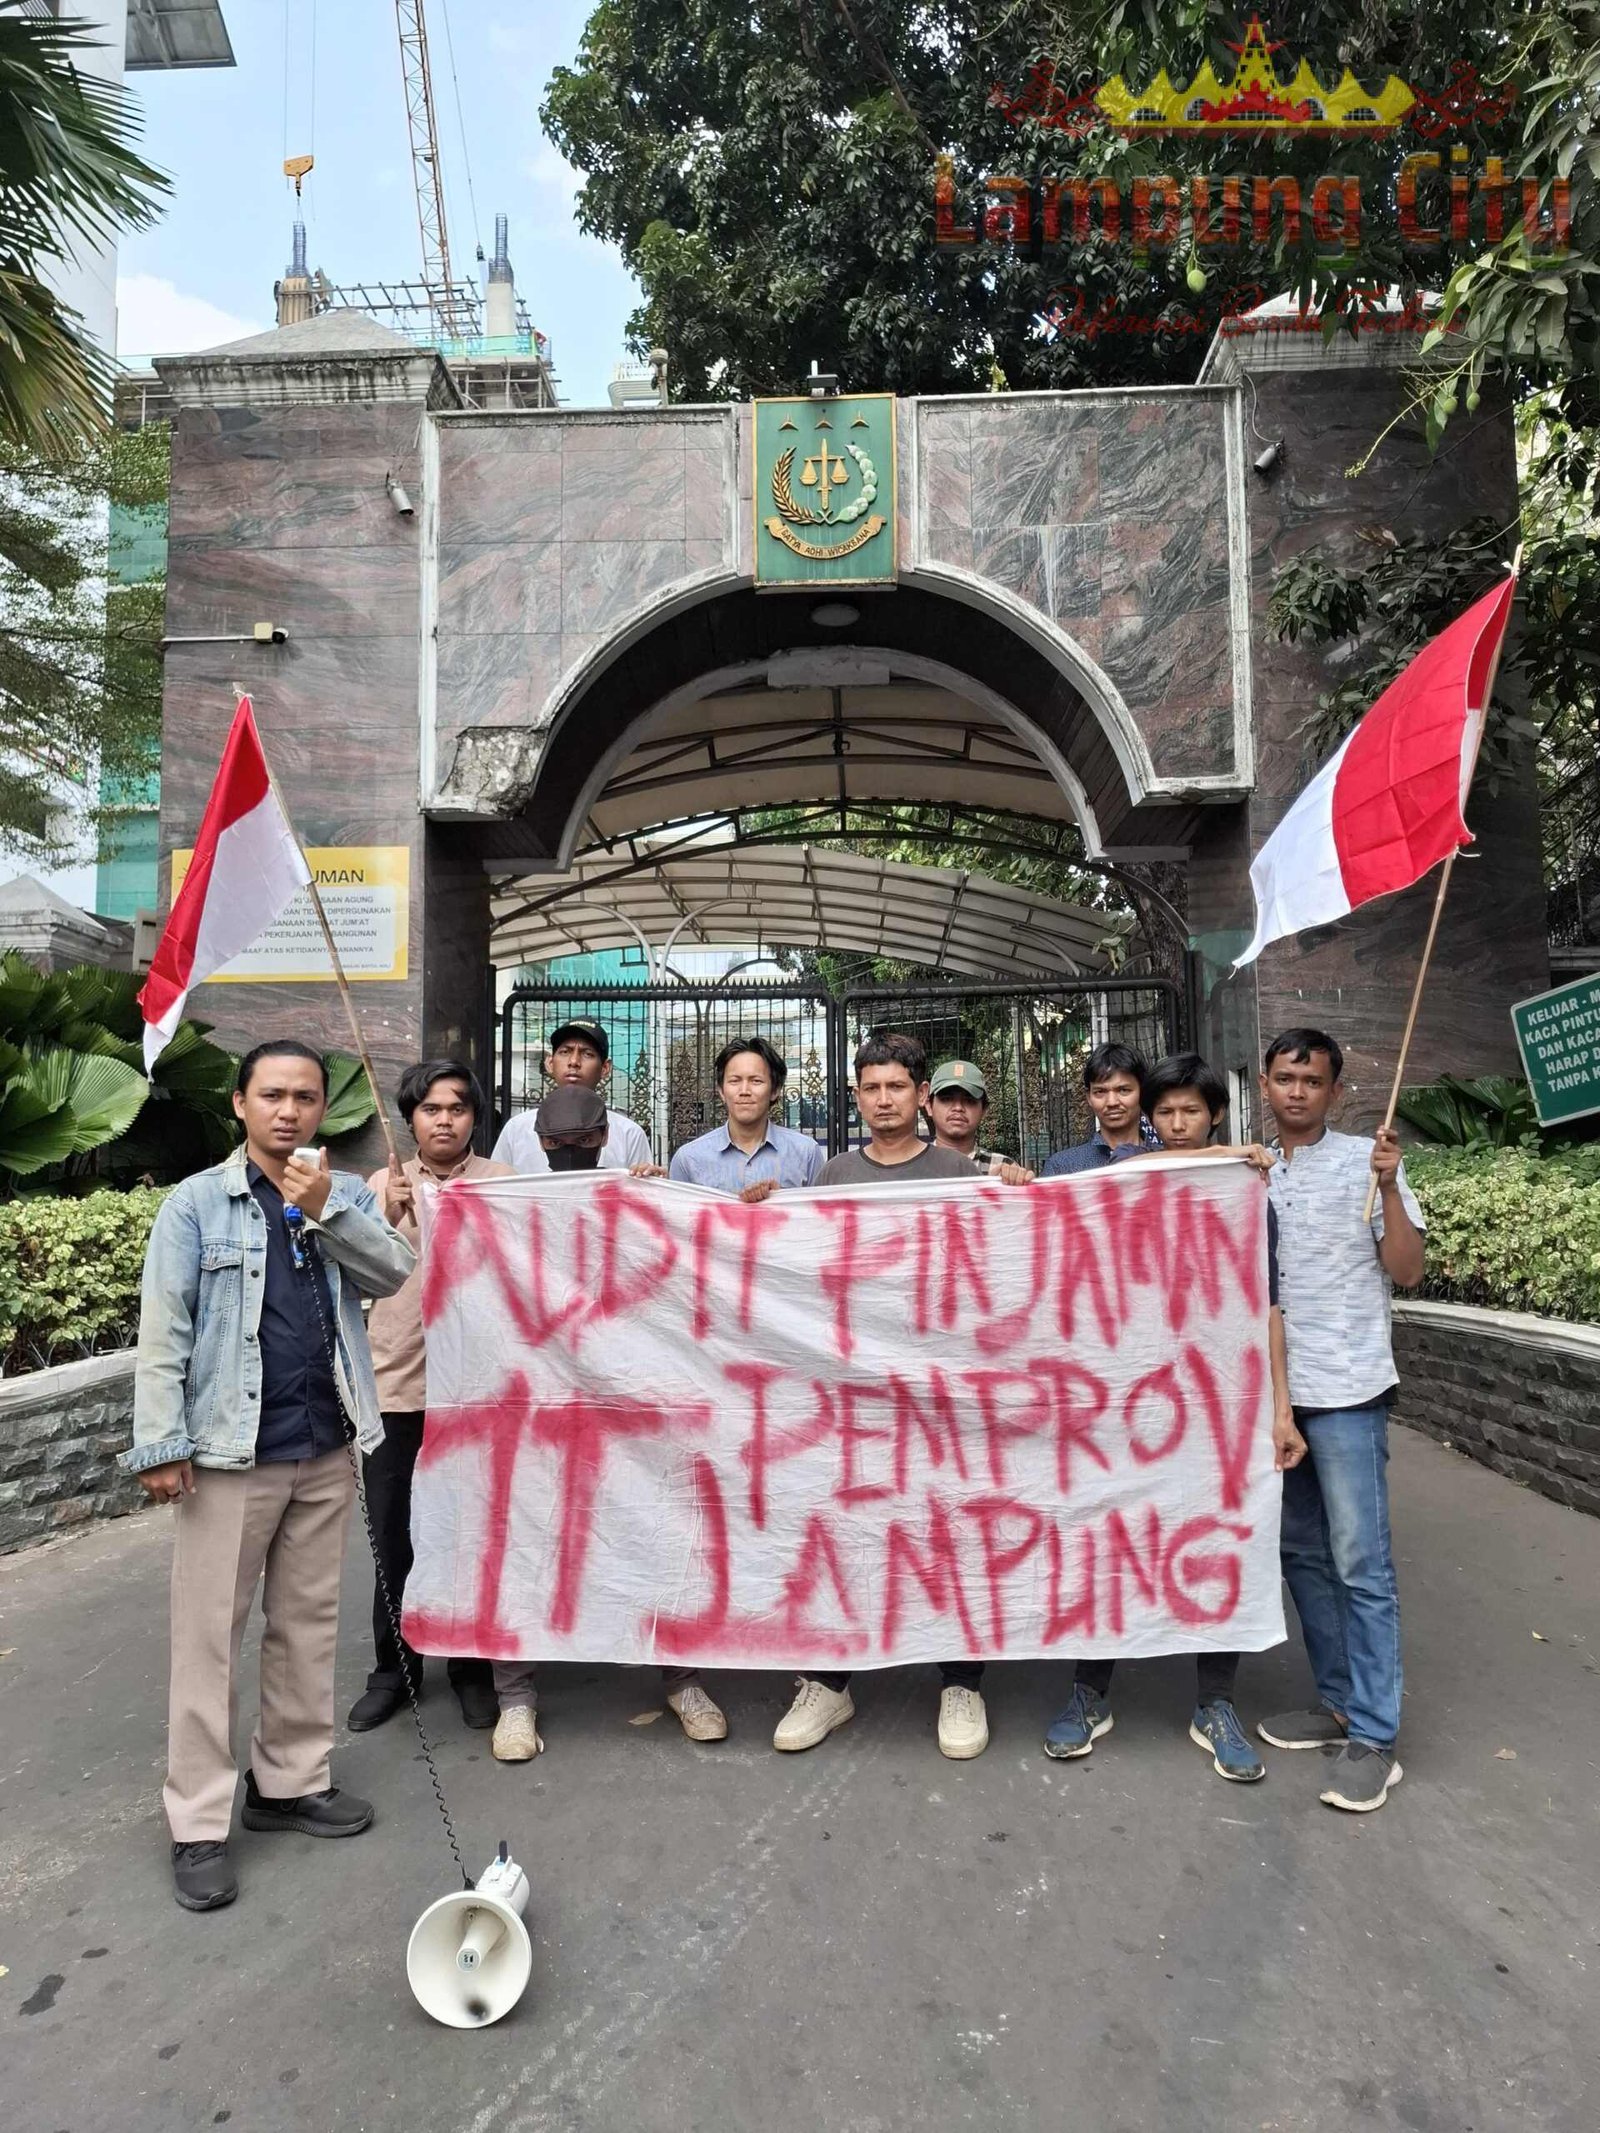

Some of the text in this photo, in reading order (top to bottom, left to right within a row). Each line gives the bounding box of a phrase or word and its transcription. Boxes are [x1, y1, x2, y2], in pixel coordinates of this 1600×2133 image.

[805, 547, 824, 556] ADHI
[314, 929, 378, 939] PEBANGUNAN
[1527, 997, 1579, 1027] KELUAR
[1525, 1007, 1600, 1046] KACA PINTU
[1537, 1040, 1565, 1060] DAN
[1545, 1050, 1590, 1075] HARAP
[1547, 1069, 1591, 1093] TANPA
[420, 1181, 789, 1349] AUDIT
[722, 1344, 1264, 1530] PEMPROV
